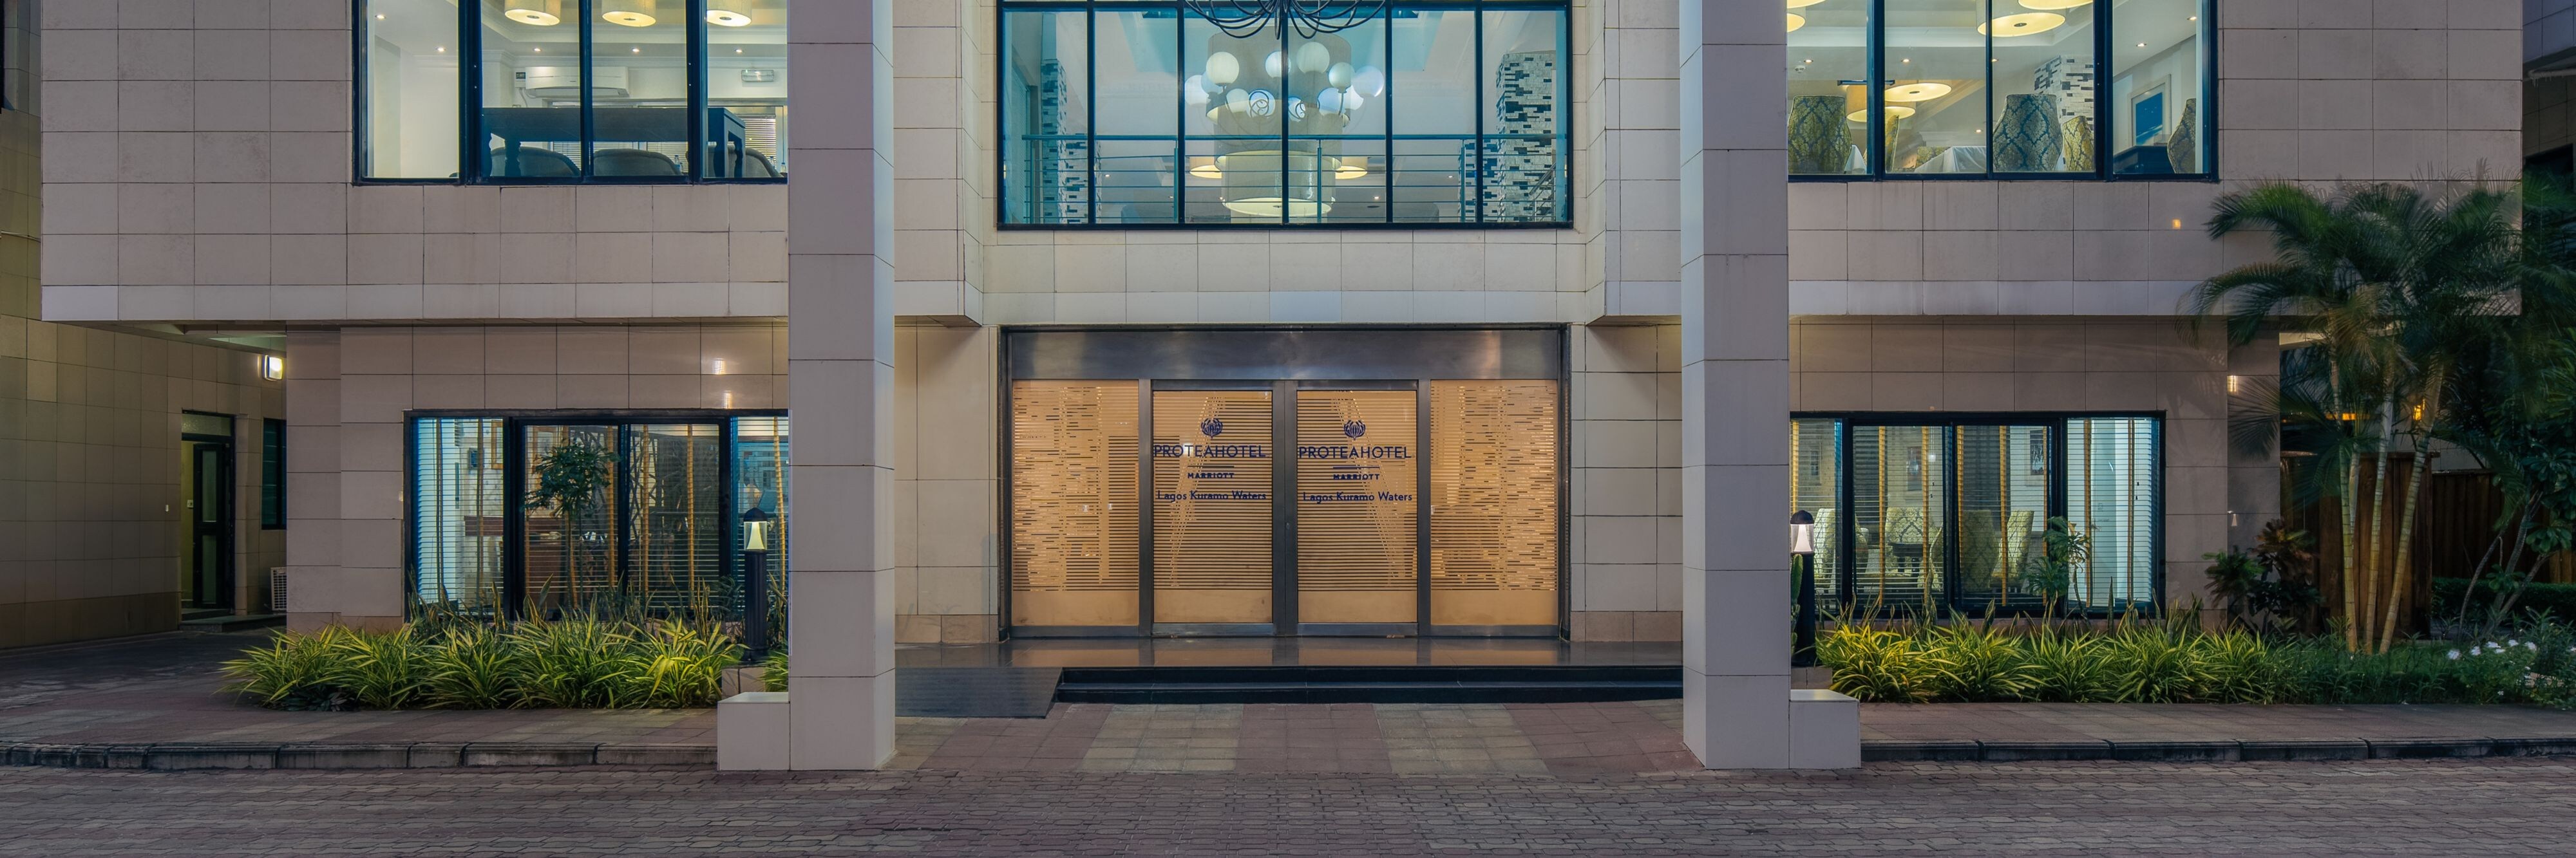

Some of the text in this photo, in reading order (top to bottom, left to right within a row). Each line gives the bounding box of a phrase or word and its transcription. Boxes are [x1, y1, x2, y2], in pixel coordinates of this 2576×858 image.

[1158, 490, 1266, 502] Lagos Kuramo Waters
[1303, 491, 1412, 504] Lagos Kuramo Waters
